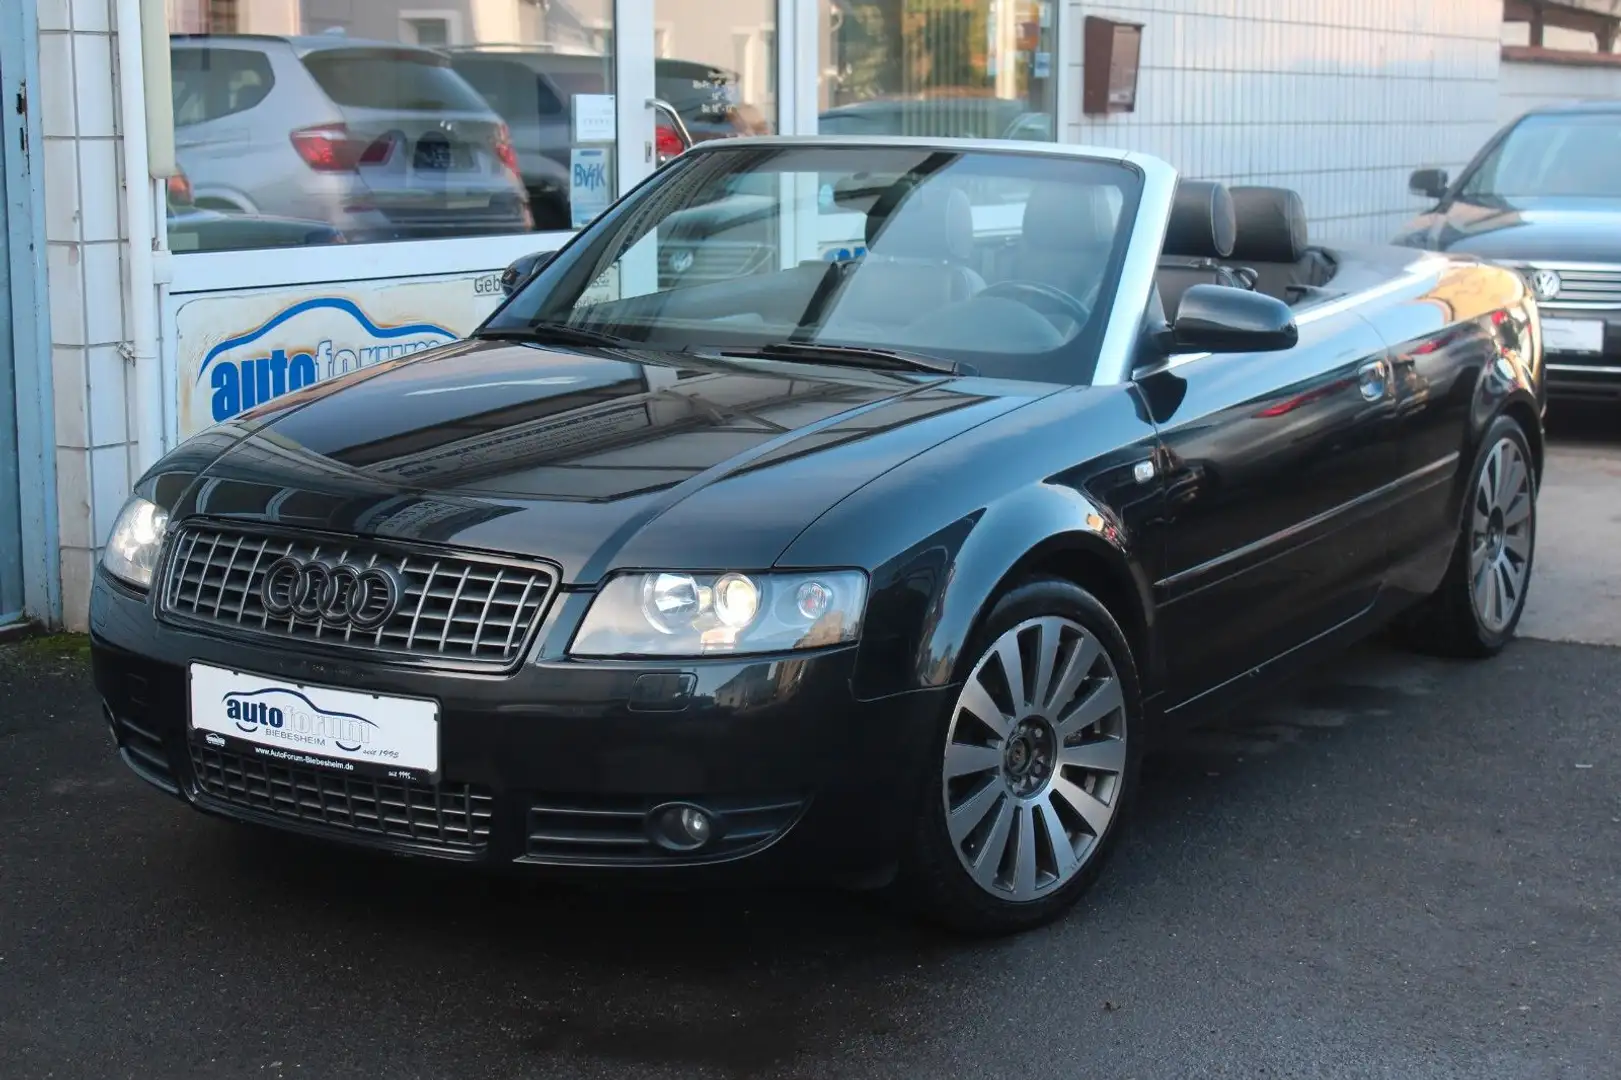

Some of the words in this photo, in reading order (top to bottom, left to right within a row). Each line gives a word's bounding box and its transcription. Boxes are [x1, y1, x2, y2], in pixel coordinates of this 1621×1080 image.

[574, 163, 606, 192] BVfK
[227, 698, 371, 744] autoforum
[265, 728, 326, 747] BIEBESHEIM
[255, 746, 354, 771] www.AutoForum-Biebesheim.de
